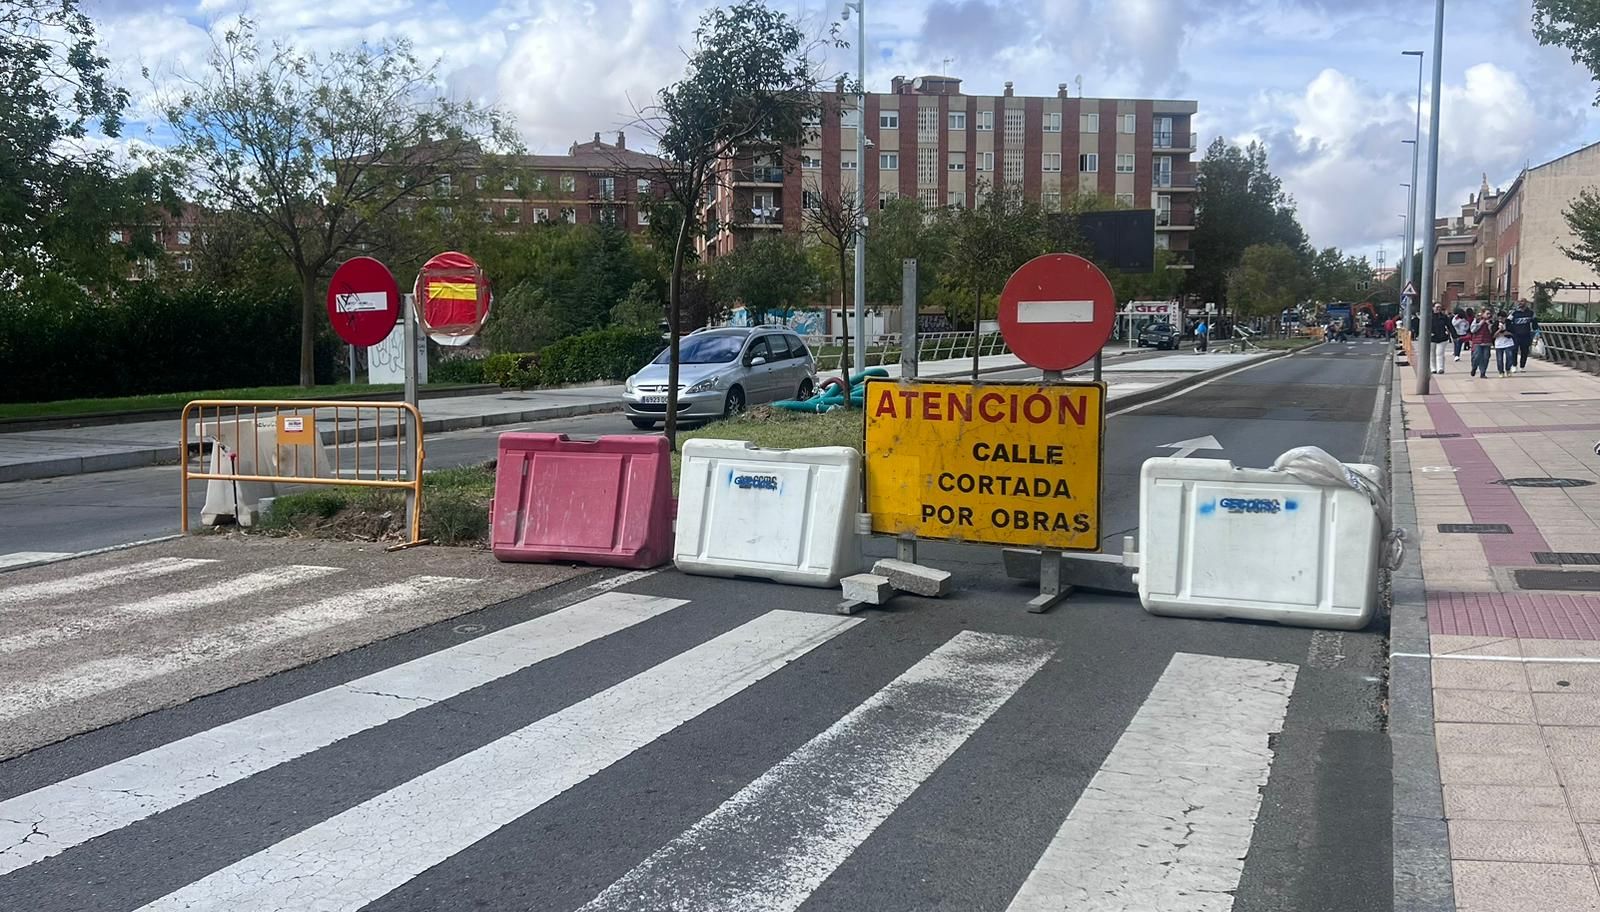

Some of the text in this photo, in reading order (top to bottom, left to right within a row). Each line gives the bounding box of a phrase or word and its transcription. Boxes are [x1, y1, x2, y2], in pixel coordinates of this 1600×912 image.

[875, 387, 1088, 426] ATENCIÓN
[972, 442, 1064, 465] CALLE
[938, 472, 1072, 499] CORTADA
[922, 504, 1091, 533] POR OBRAS
